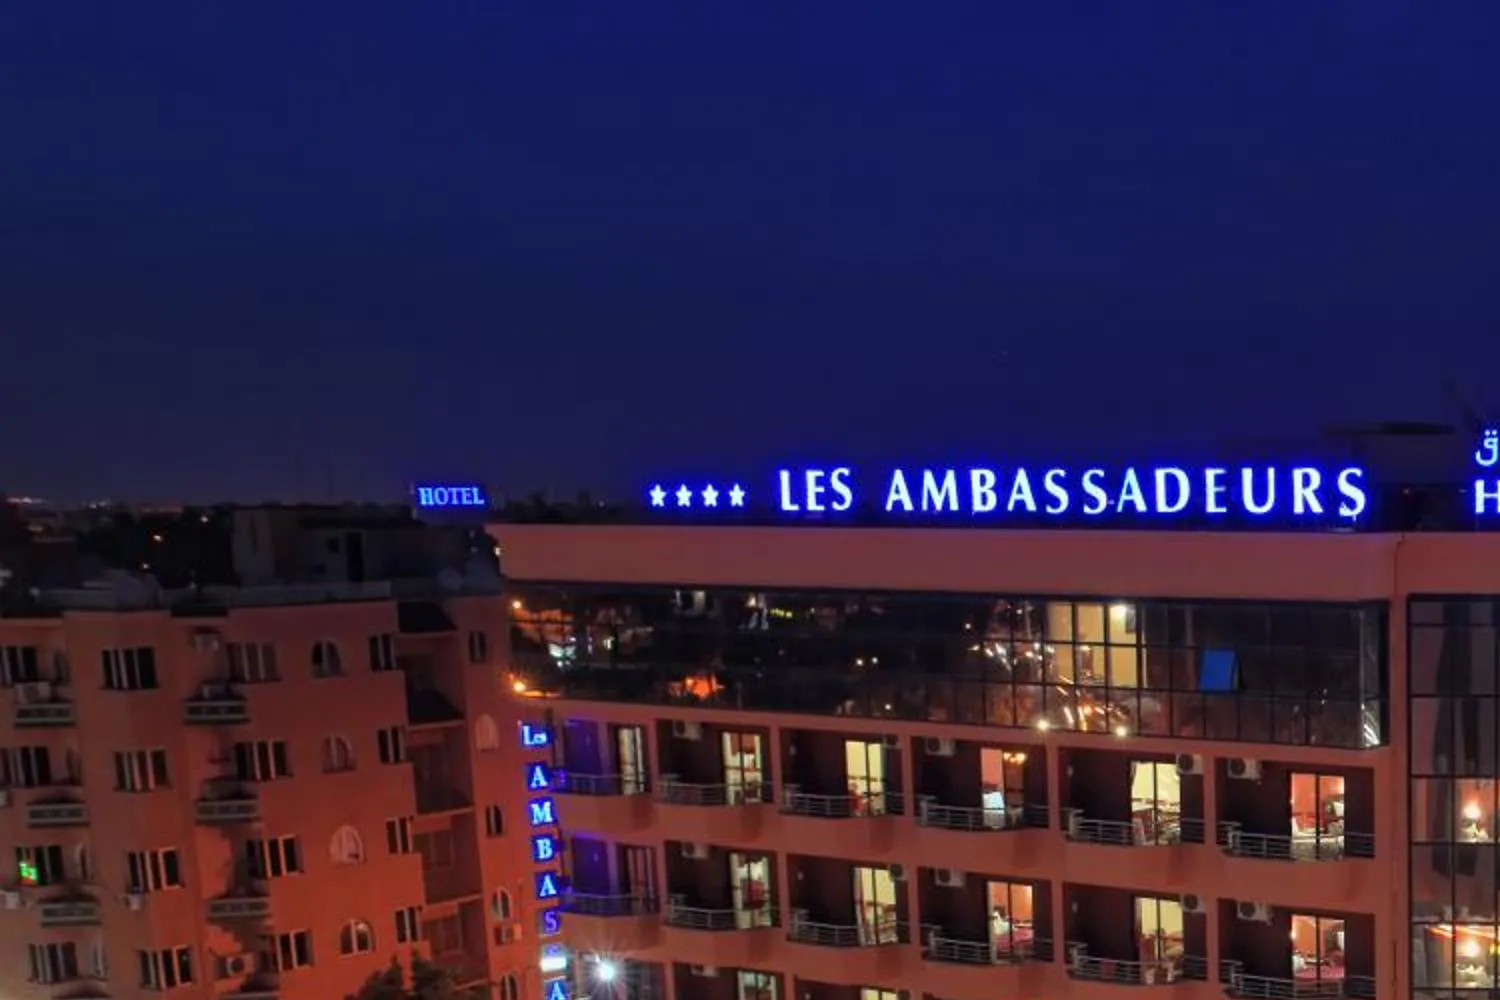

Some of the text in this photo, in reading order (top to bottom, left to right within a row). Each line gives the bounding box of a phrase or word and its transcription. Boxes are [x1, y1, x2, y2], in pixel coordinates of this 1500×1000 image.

[418, 486, 485, 506] HOTEL
[779, 466, 1367, 518] LES AMBASSADEURS
